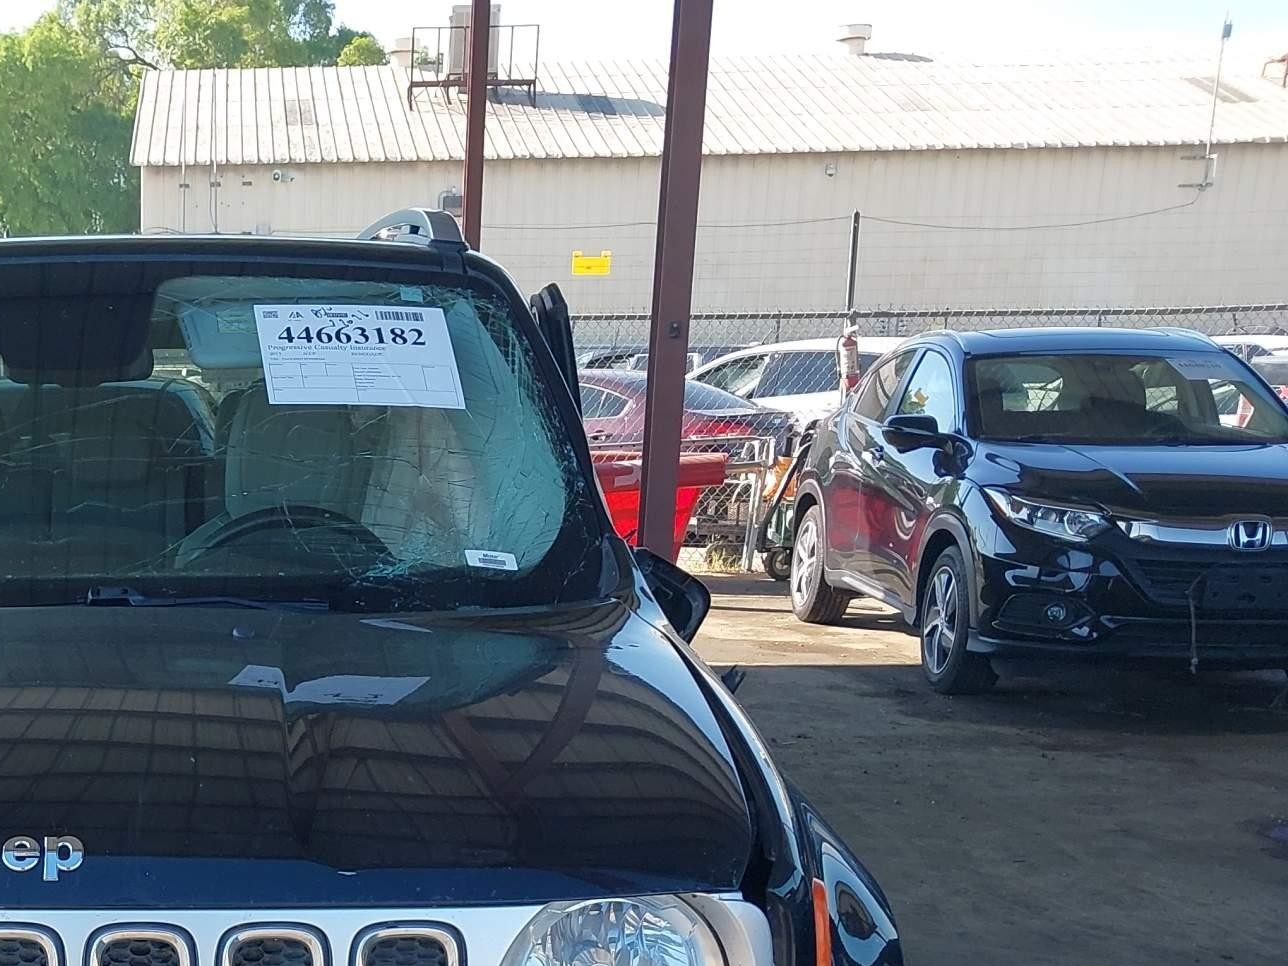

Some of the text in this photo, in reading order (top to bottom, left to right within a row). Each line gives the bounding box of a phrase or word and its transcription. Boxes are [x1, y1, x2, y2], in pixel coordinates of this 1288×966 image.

[278, 326, 426, 346] 44663182
[268, 344, 313, 352] Progressive
[314, 344, 348, 352] Casualty
